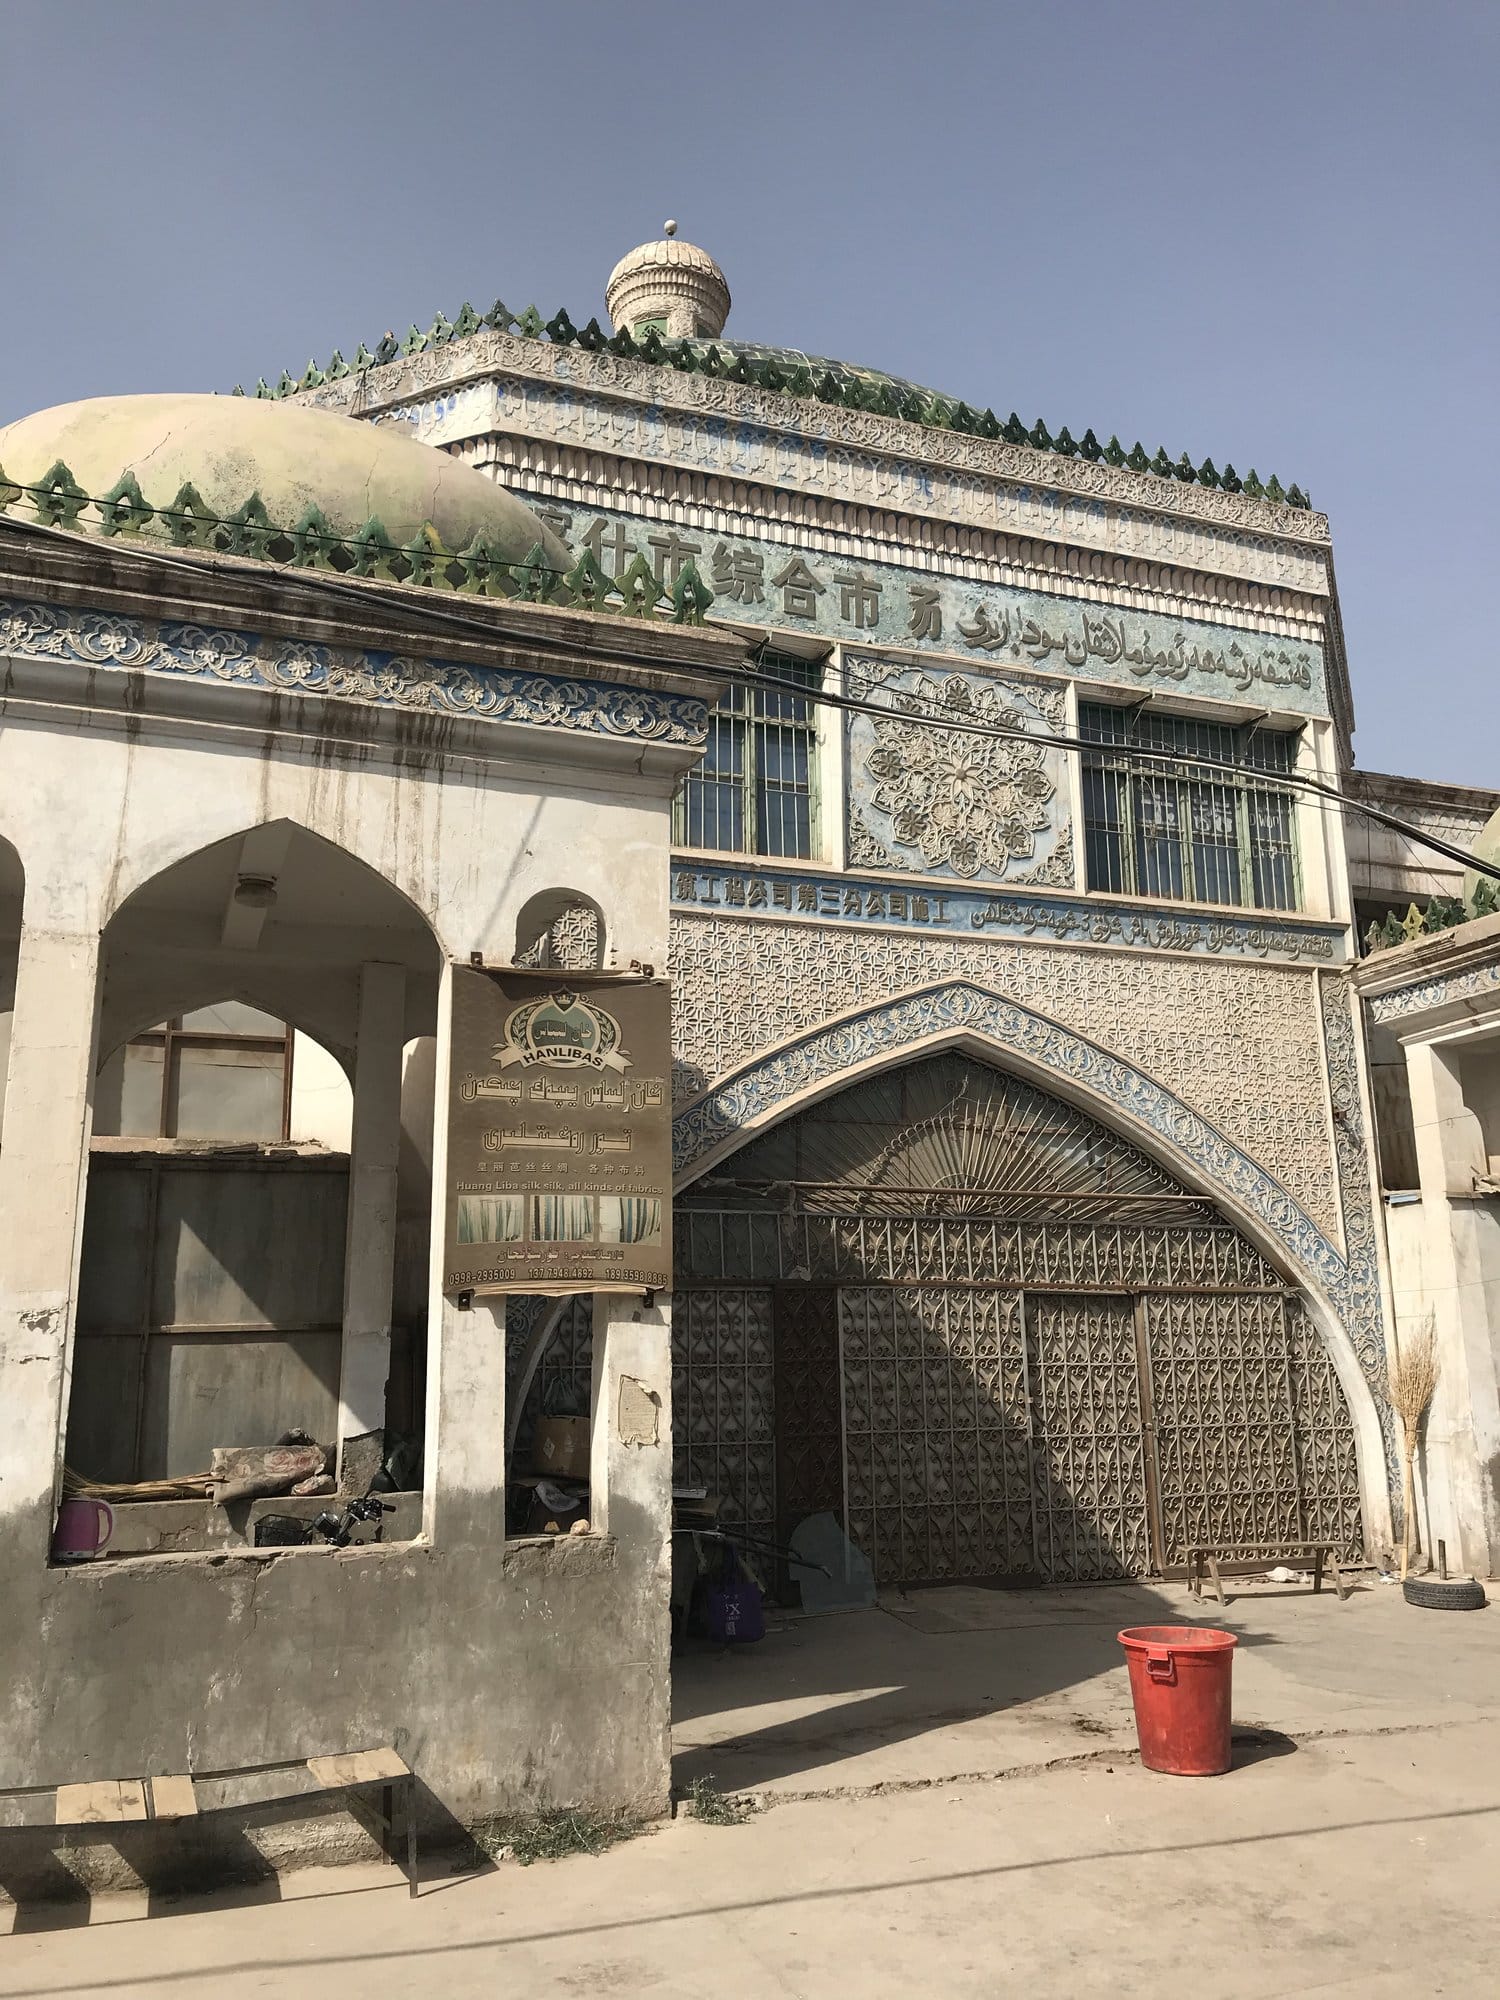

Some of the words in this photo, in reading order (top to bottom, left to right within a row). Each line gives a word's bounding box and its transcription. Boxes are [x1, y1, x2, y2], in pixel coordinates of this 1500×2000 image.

[670, 871, 951, 924] 筑工程公司第三分公司施工
[523, 1047, 604, 1067] HANLIBAS
[456, 1181, 493, 1193] Huang
[496, 1180, 519, 1191] Liba
[521, 1180, 541, 1191] silk
[543, 1180, 566, 1192] silk,
[568, 1181, 582, 1192] all
[584, 1181, 613, 1192] kinds
[615, 1181, 628, 1193] of
[628, 1183, 664, 1196] fabrics
